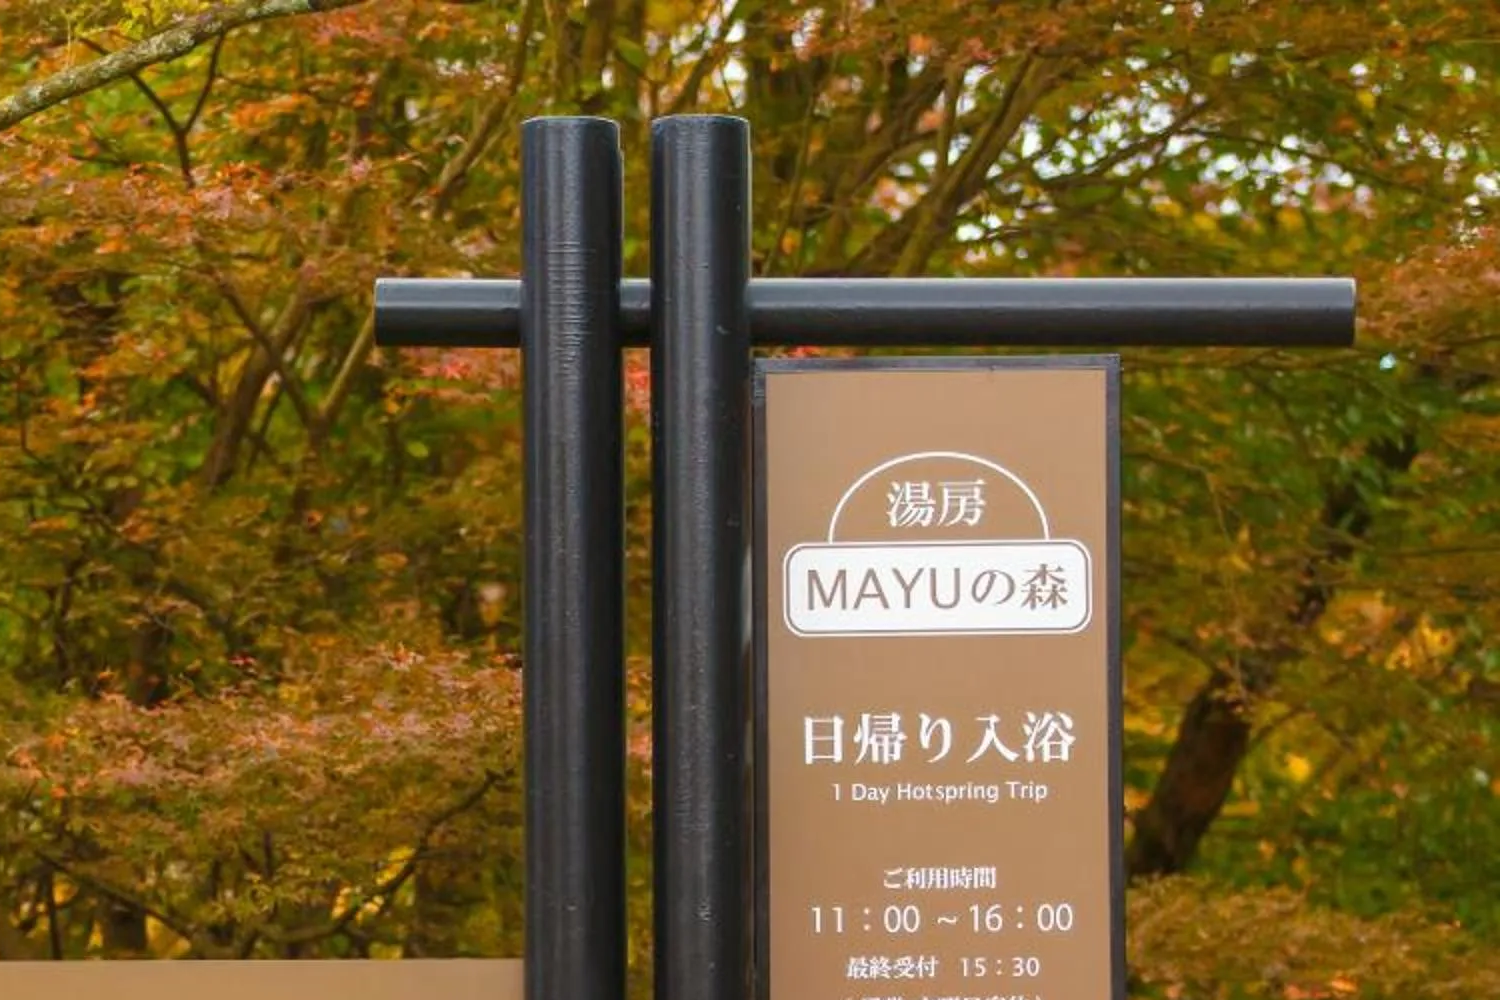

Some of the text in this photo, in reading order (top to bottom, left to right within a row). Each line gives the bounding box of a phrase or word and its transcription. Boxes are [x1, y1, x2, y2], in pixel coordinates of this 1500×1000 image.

[887, 479, 985, 527] 湯房
[807, 563, 1068, 611] MAYUの森
[804, 712, 1076, 765] 日帰り入浴
[851, 783, 890, 804] Day
[897, 783, 999, 803] Hotspring
[1006, 781, 1048, 802] Trip
[884, 867, 997, 889] ご利用時間
[847, 955, 1041, 979] 最終受付 15:30
